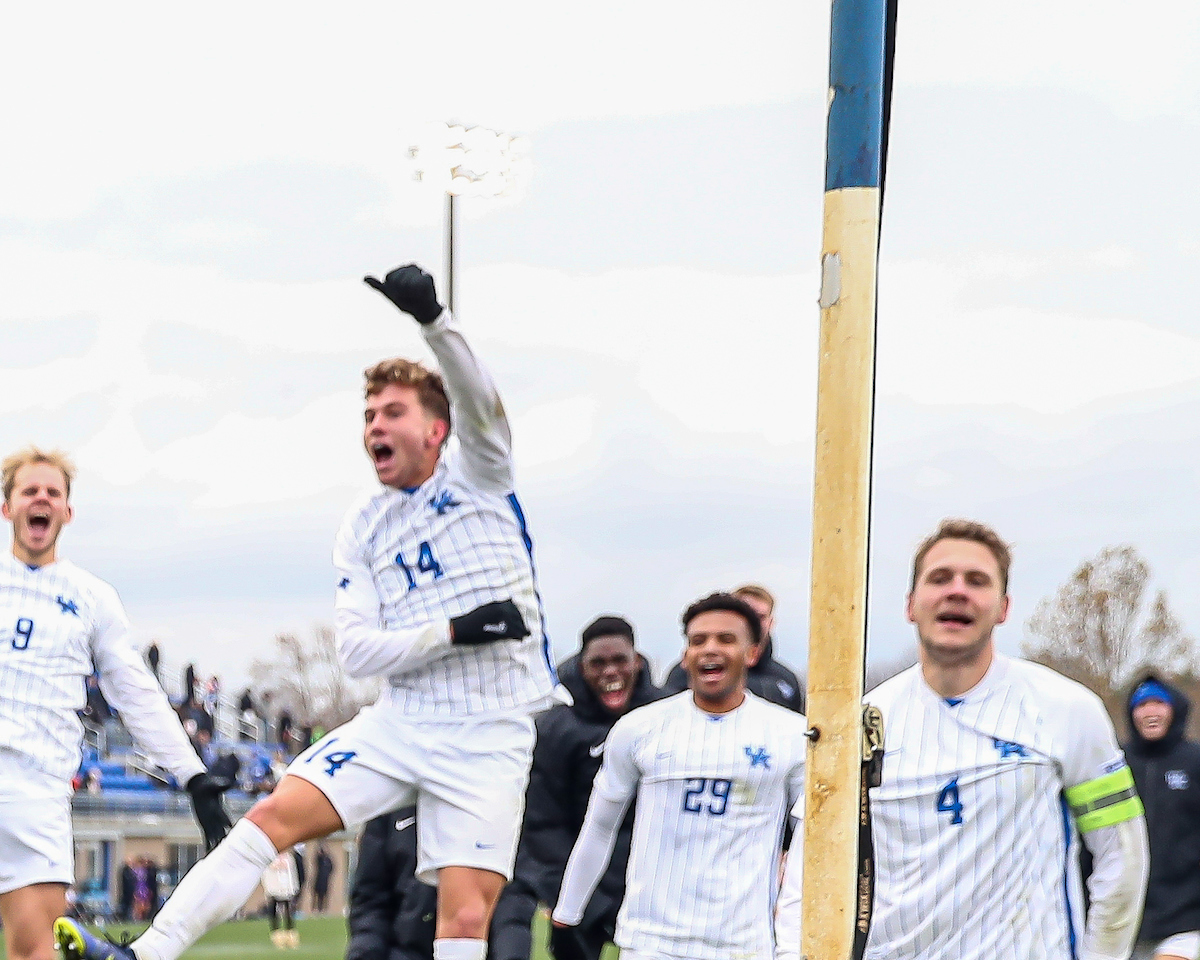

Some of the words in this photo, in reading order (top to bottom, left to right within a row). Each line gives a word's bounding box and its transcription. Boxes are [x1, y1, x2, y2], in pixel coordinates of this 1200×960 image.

[396, 541, 444, 591] 14
[12, 618, 34, 651] 9
[305, 738, 356, 777] 14
[684, 777, 732, 816] 29
[937, 775, 964, 825] 4
